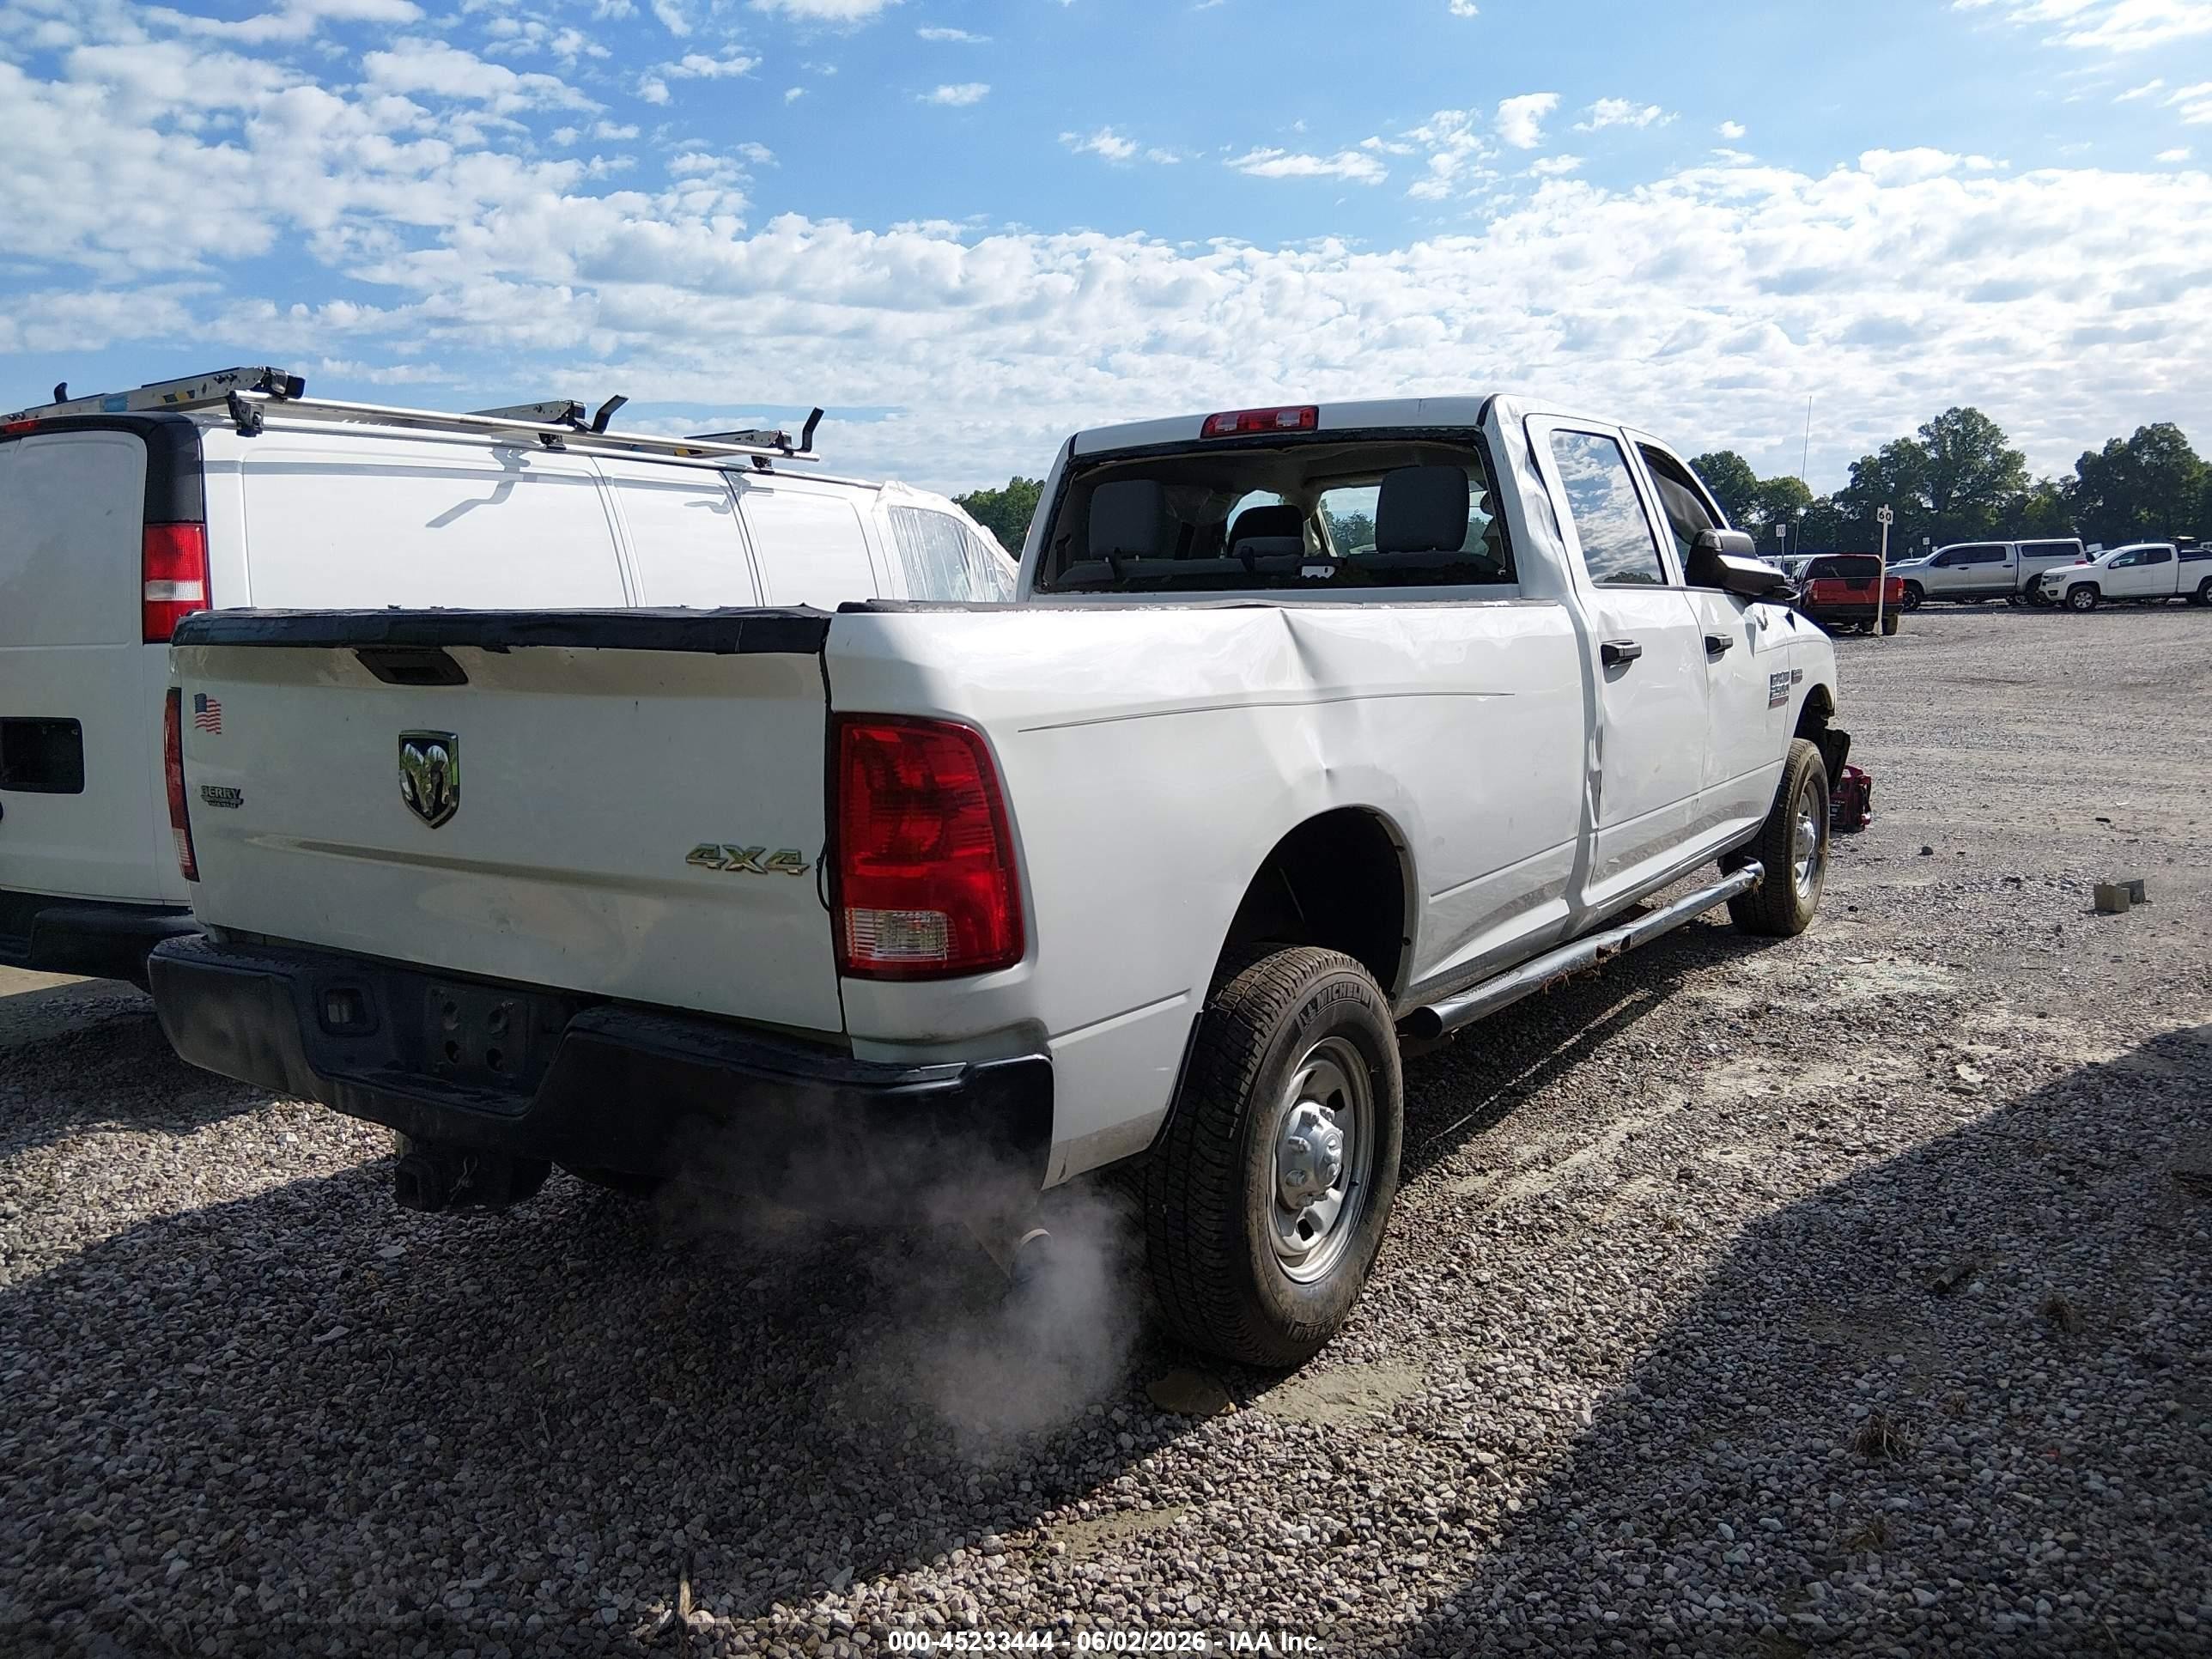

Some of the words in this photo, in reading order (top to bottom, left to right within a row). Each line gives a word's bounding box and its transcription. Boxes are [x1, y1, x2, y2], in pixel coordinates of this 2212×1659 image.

[1878, 511, 1892, 521] 60
[1777, 526, 1785, 534] 70
[201, 786, 240, 799] BERRY
[1316, 982, 1372, 1010] MICHELIN
